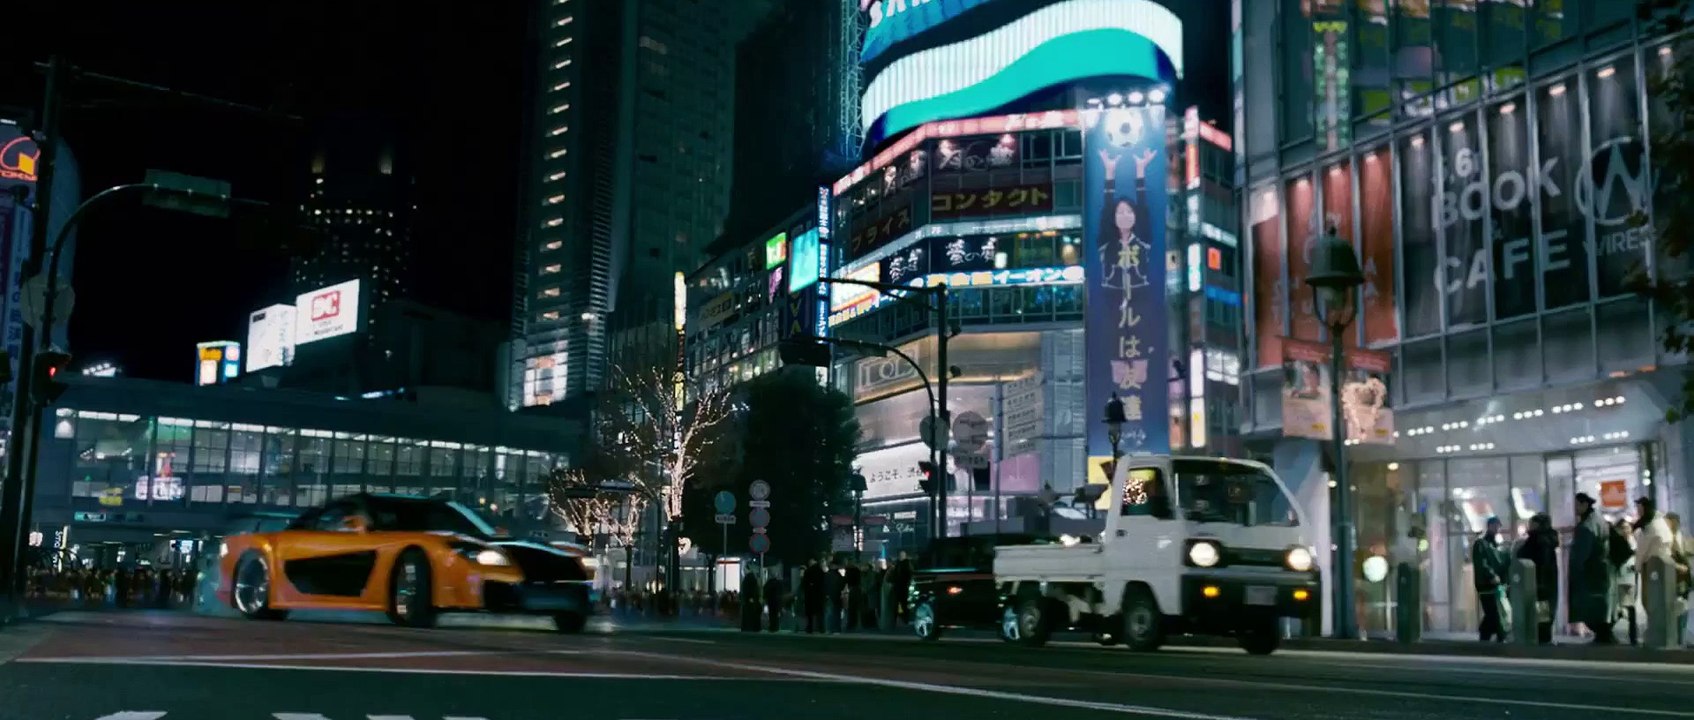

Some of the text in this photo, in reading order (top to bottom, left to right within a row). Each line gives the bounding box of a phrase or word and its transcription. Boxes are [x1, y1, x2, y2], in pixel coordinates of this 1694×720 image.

[931, 188, 1049, 212] コンタクト
[1431, 157, 1561, 231] BOOK
[1434, 229, 1571, 294] CAFE
